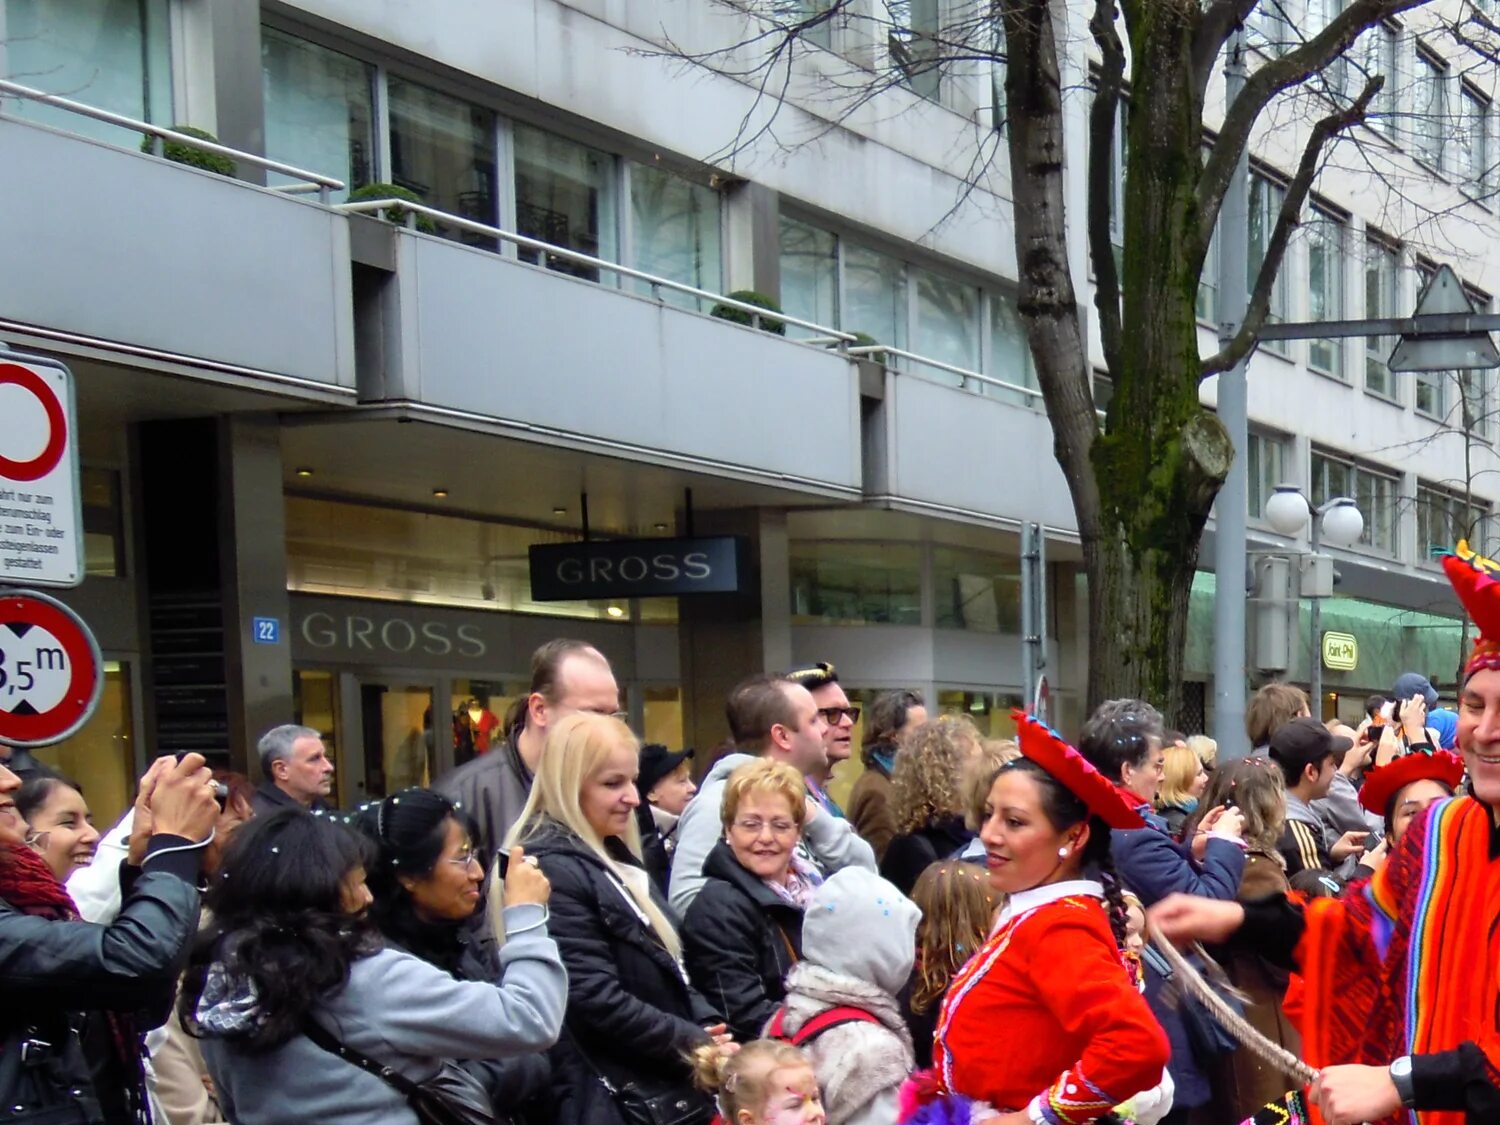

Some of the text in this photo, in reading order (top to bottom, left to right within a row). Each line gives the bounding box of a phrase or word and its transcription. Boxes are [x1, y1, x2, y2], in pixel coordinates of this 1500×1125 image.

[18, 492, 32, 503] nur
[35, 494, 54, 505] zum
[5, 524, 24, 535] zum
[45, 526, 65, 539] oder
[4, 556, 43, 571] gestattet
[556, 552, 711, 584] GROSS
[258, 621, 275, 640] 22
[302, 612, 486, 657] GROSS
